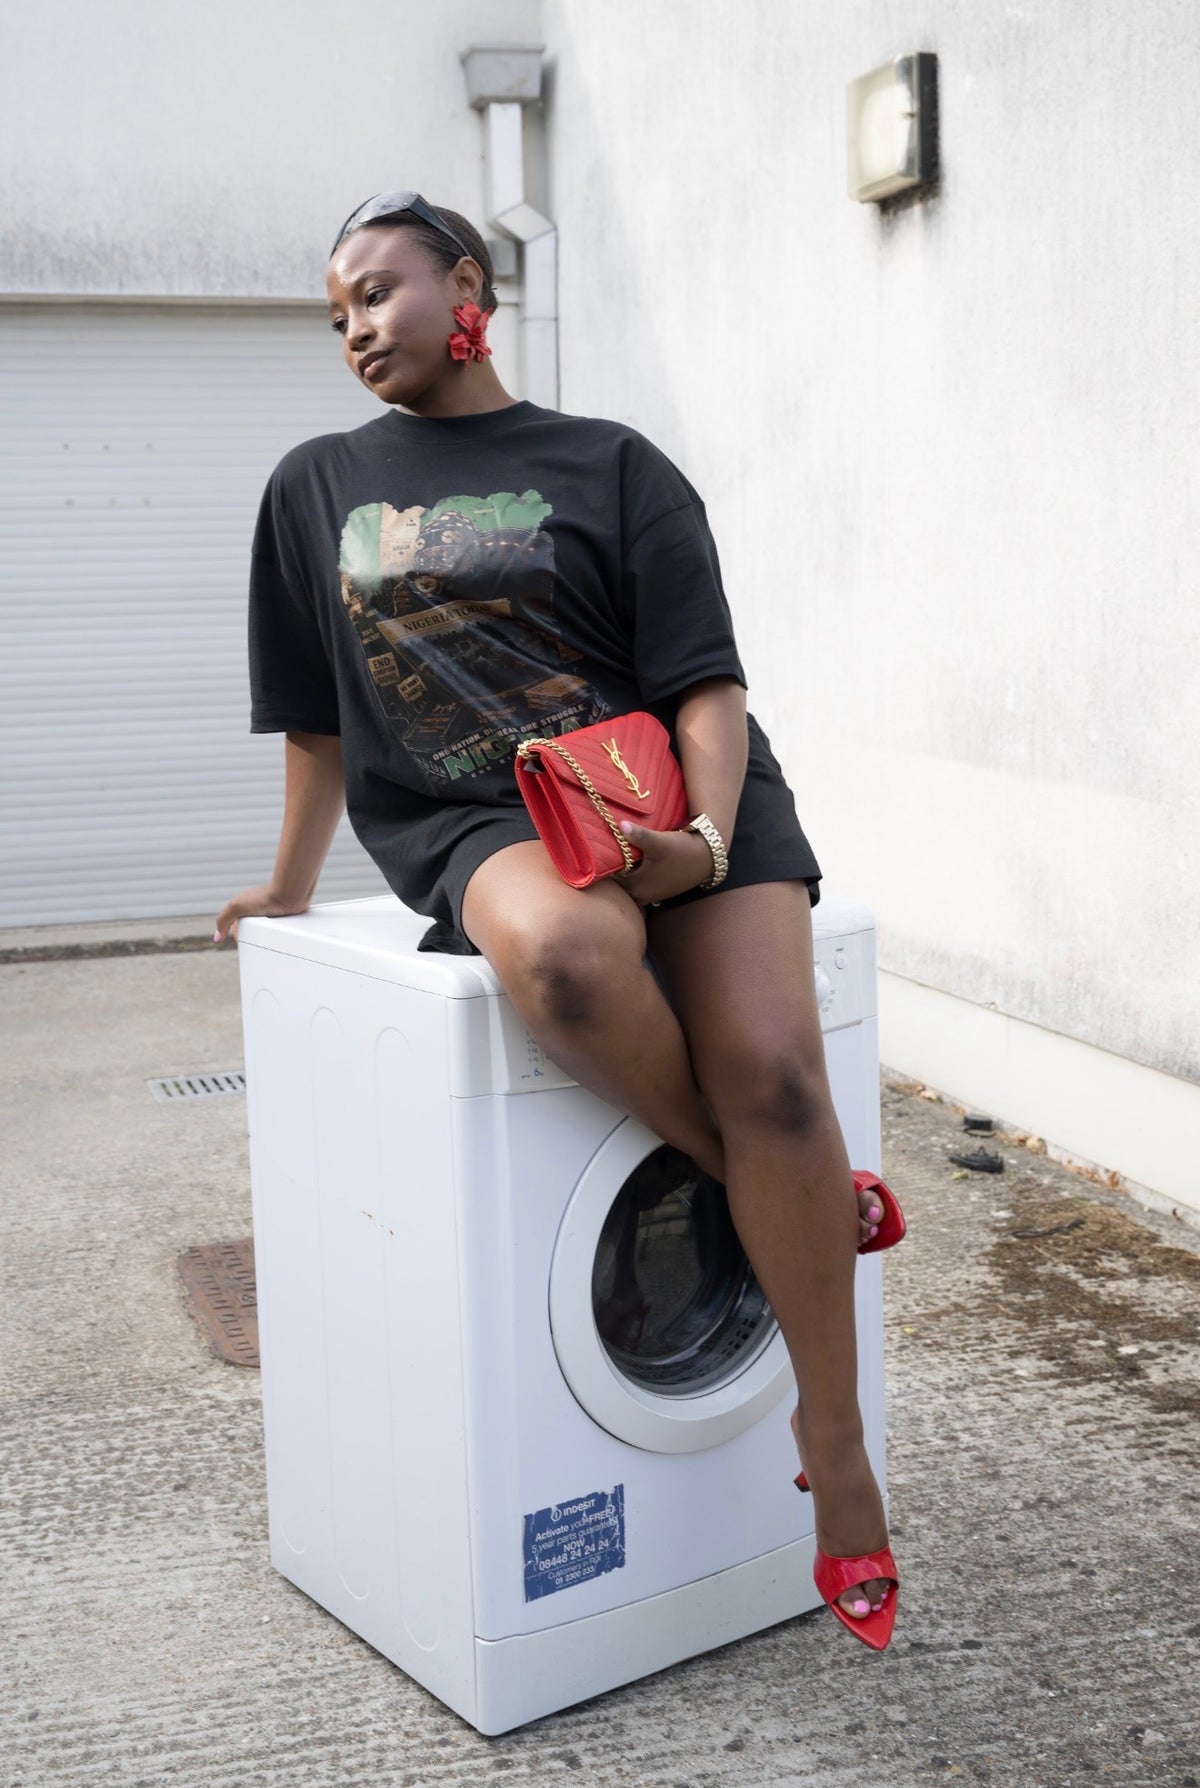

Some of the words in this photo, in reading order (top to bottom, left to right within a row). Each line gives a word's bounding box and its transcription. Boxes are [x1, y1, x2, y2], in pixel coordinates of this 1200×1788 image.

[402, 609, 454, 633] NIGERIA
[372, 656, 391, 670] END
[520, 721, 539, 734] ONE
[535, 1525, 570, 1542] Activate
[531, 1544, 538, 1554] 5
[539, 1539, 556, 1553] year
[557, 1532, 577, 1546] parts
[563, 1536, 585, 1552] NOW
[539, 1553, 568, 1571] 08448
[570, 1548, 582, 1560] 24
[584, 1543, 596, 1555] 24
[598, 1538, 610, 1550] 24
[555, 1576, 564, 1585] 01
